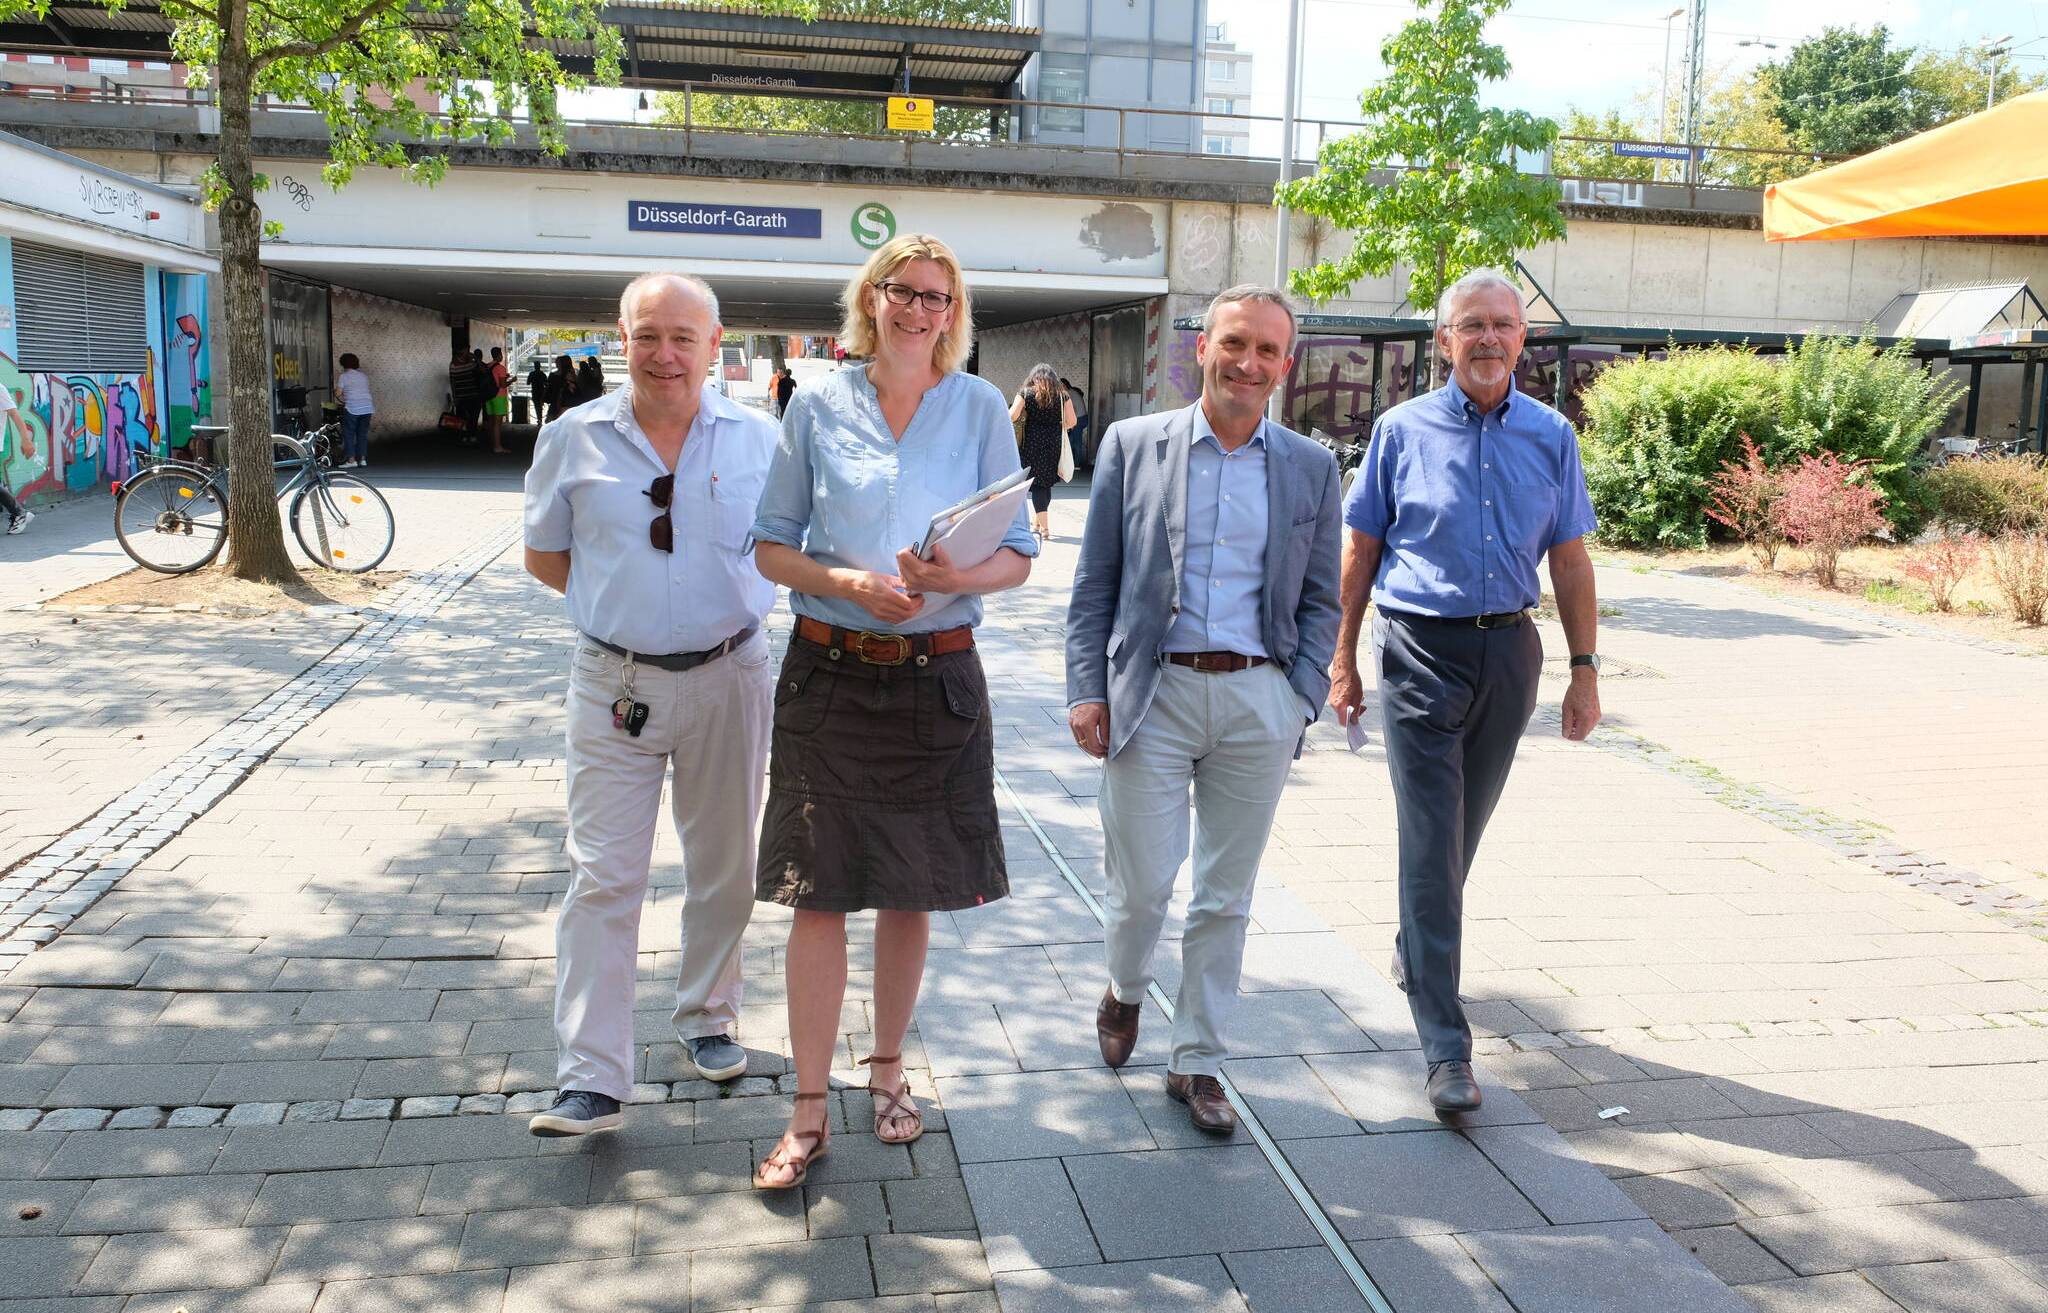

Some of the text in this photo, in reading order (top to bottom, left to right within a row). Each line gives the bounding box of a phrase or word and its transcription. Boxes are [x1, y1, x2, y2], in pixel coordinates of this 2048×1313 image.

[711, 73, 796, 87] Düsseldorf-Garath
[637, 206, 787, 228] Düsseldorf-Garath
[858, 207, 890, 246] S
